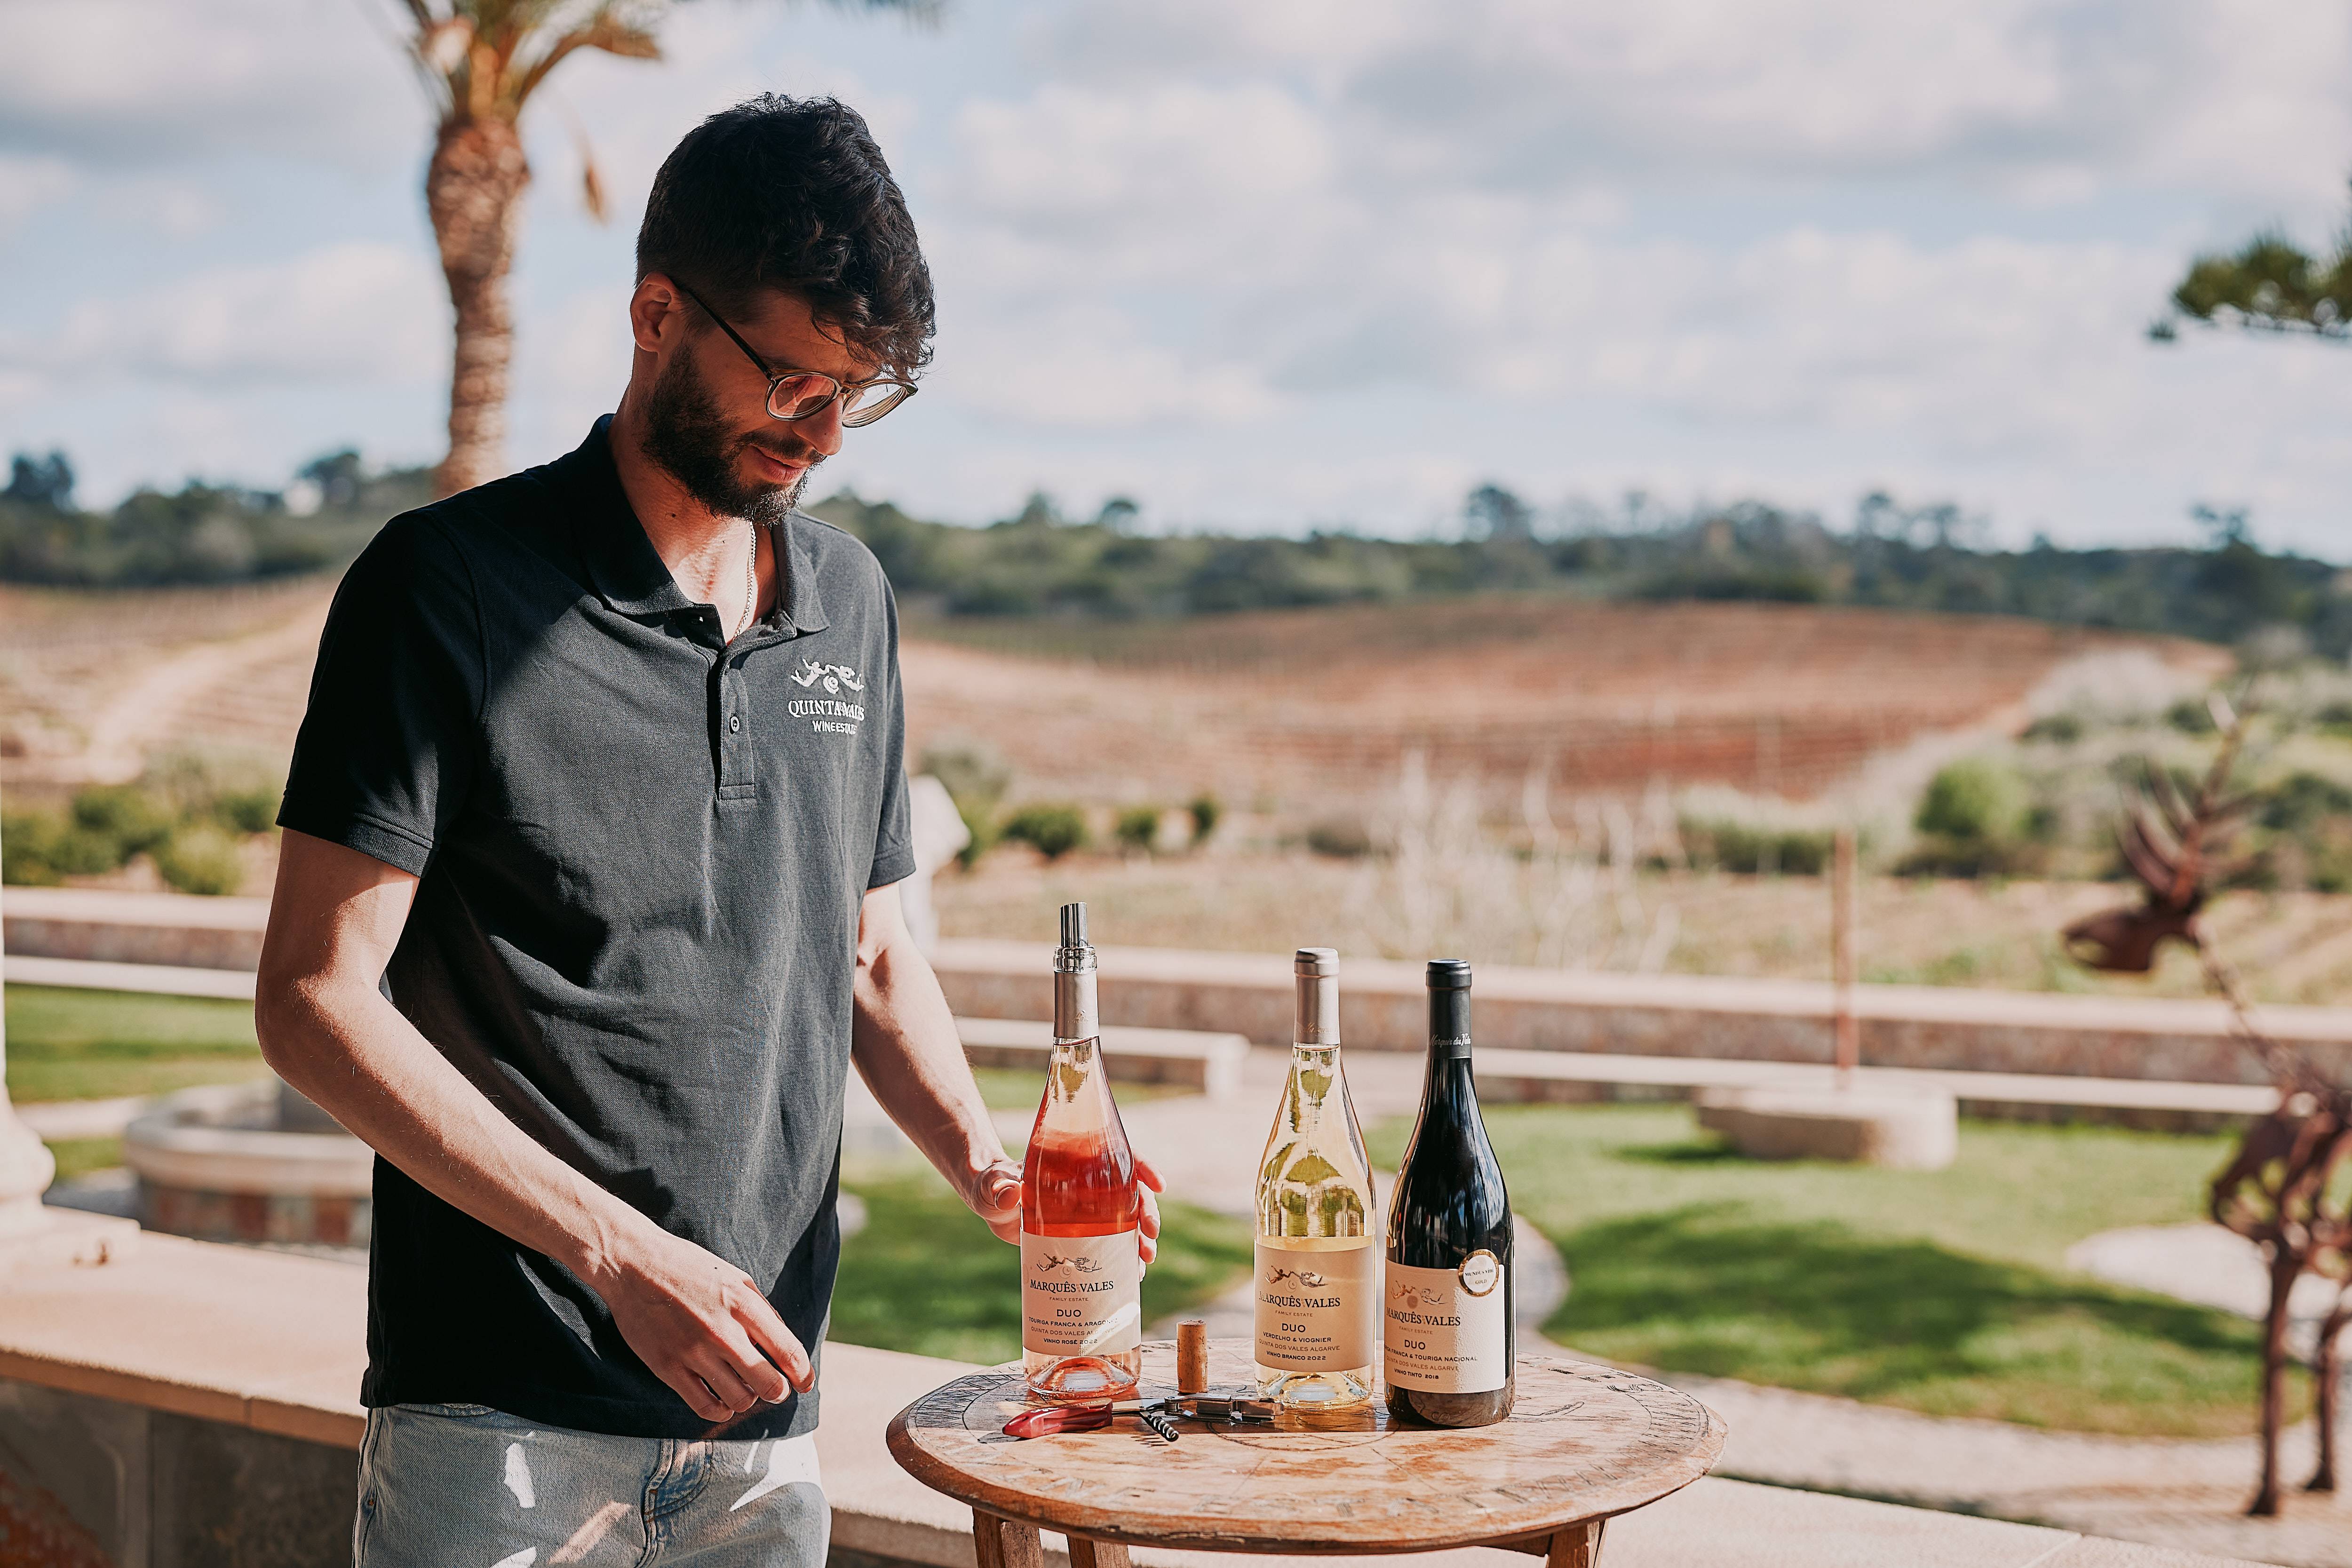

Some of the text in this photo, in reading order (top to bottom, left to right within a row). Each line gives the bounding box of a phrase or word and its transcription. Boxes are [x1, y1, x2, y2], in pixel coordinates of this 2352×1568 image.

[788, 700, 842, 718] QUINTA
[812, 720, 858, 735] WINE ESTATE
[1030, 1279, 1076, 1294] MARQUÊS
[1080, 1281, 1113, 1292] VALES
[1259, 1291, 1301, 1307] MARQUÊS
[1304, 1297, 1340, 1308] VALES
[1028, 1316, 1049, 1325] TOURIGA
[1386, 1306, 1422, 1324] MARQUÊS
[1425, 1315, 1461, 1326] VALES
[1282, 1323, 1306, 1333] DUO
[1263, 1331, 1291, 1341] VERDELHO
[1259, 1338, 1273, 1347] QUINTA
[1404, 1339, 1426, 1350] DUO
[1391, 1348, 1408, 1358] FRANCA
